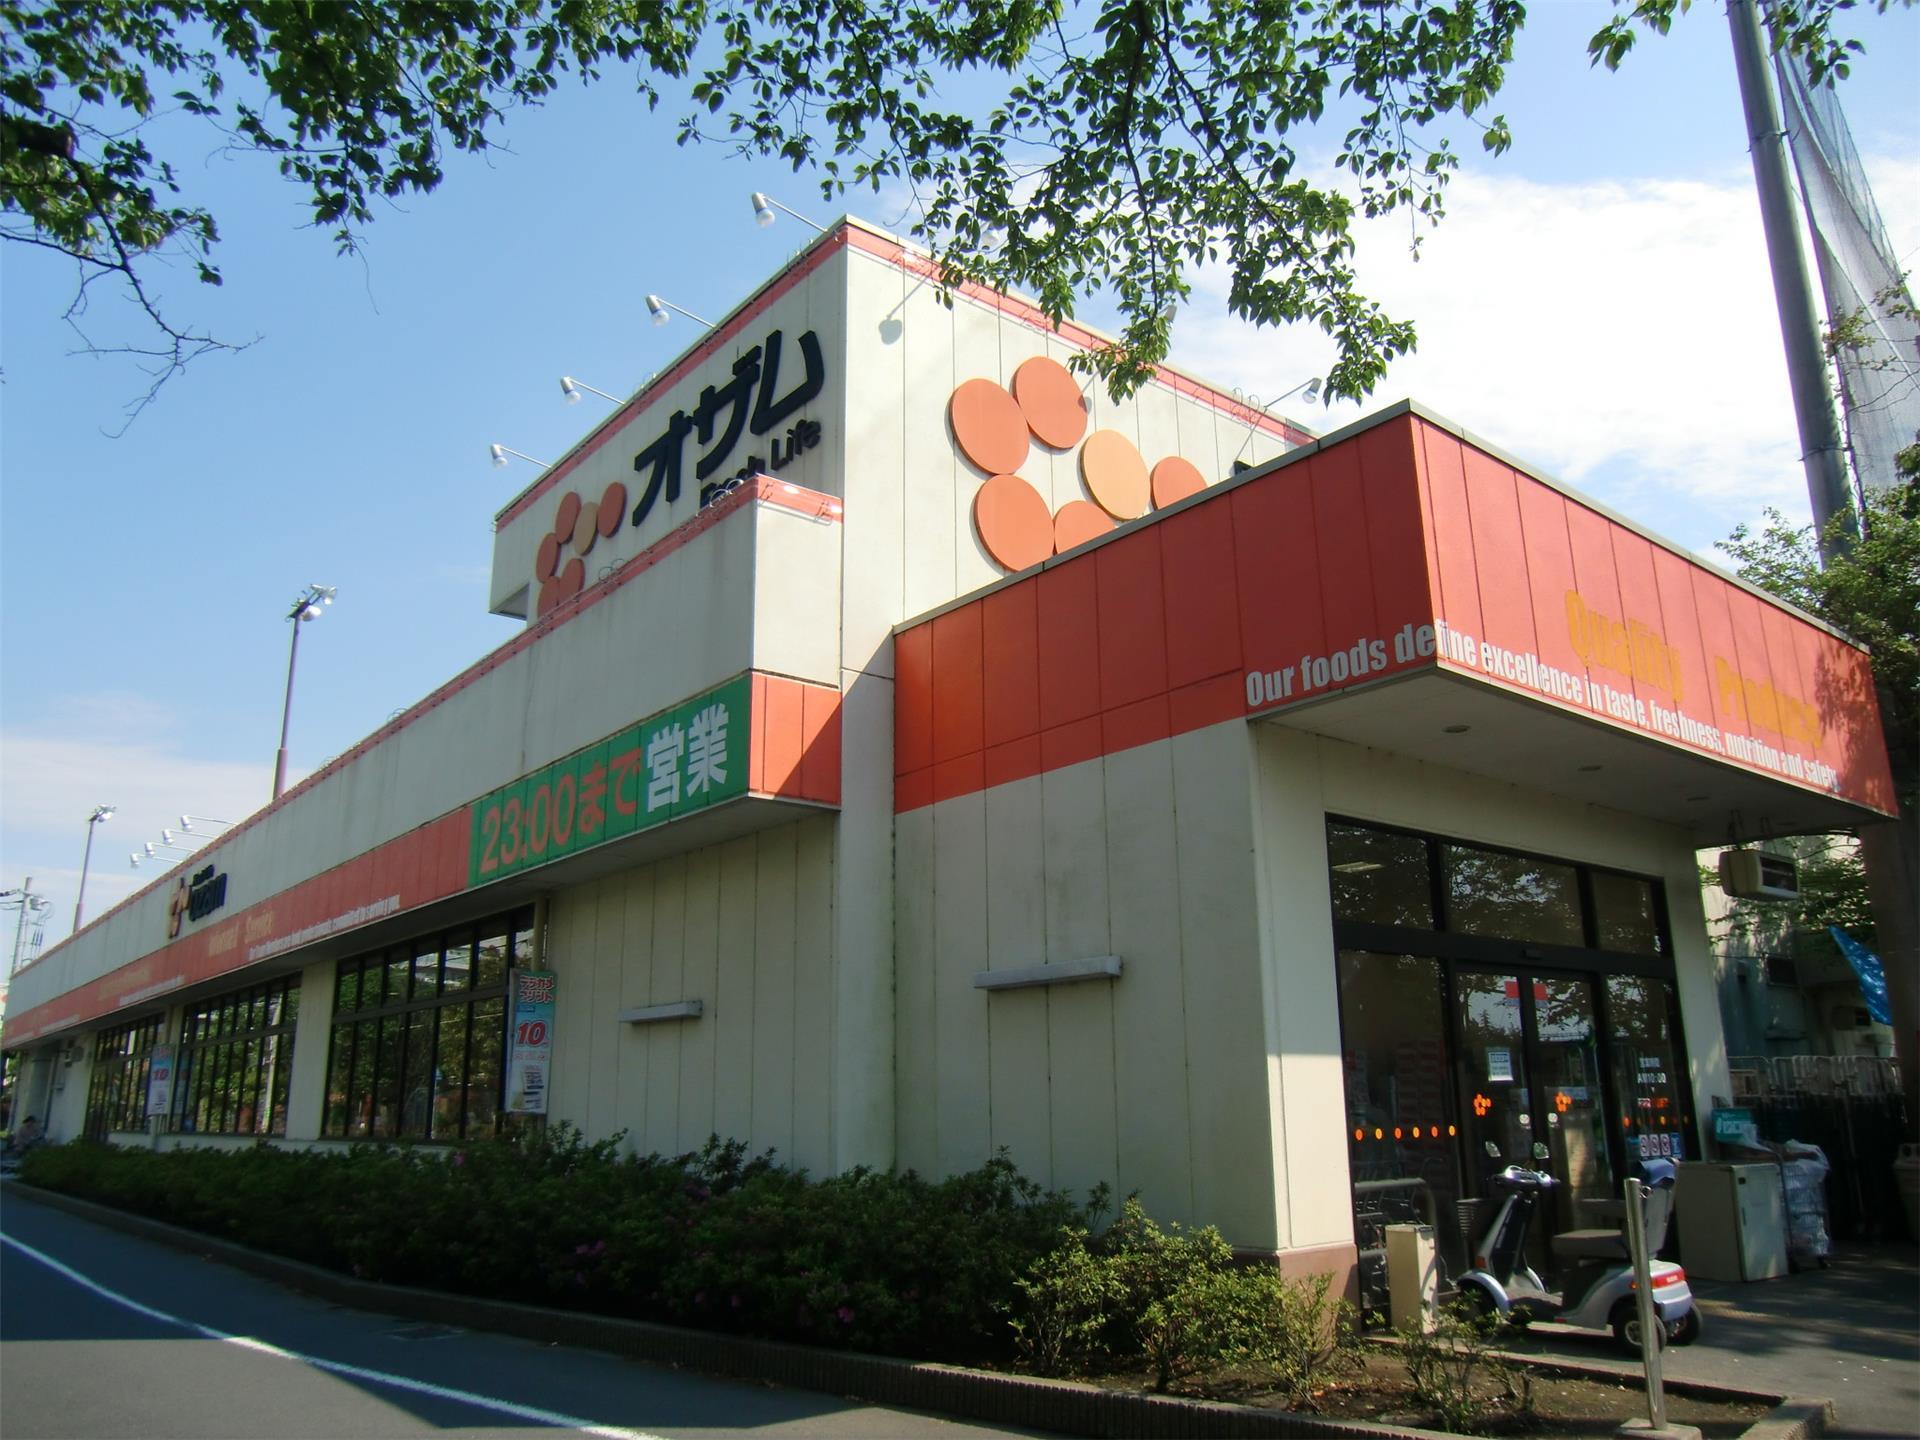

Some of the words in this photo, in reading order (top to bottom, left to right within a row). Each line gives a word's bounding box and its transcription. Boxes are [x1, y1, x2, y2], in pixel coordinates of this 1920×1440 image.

[771, 419, 822, 471] Life
[1246, 664, 1294, 707] Our
[1301, 637, 1388, 692] foods
[1480, 641, 1584, 705] excellence
[1584, 675, 1603, 712] in
[1604, 683, 1651, 726] taste,
[1724, 732, 1781, 773] nutrition
[1780, 750, 1804, 778] and
[480, 703, 730, 874] 23:00まで営業
